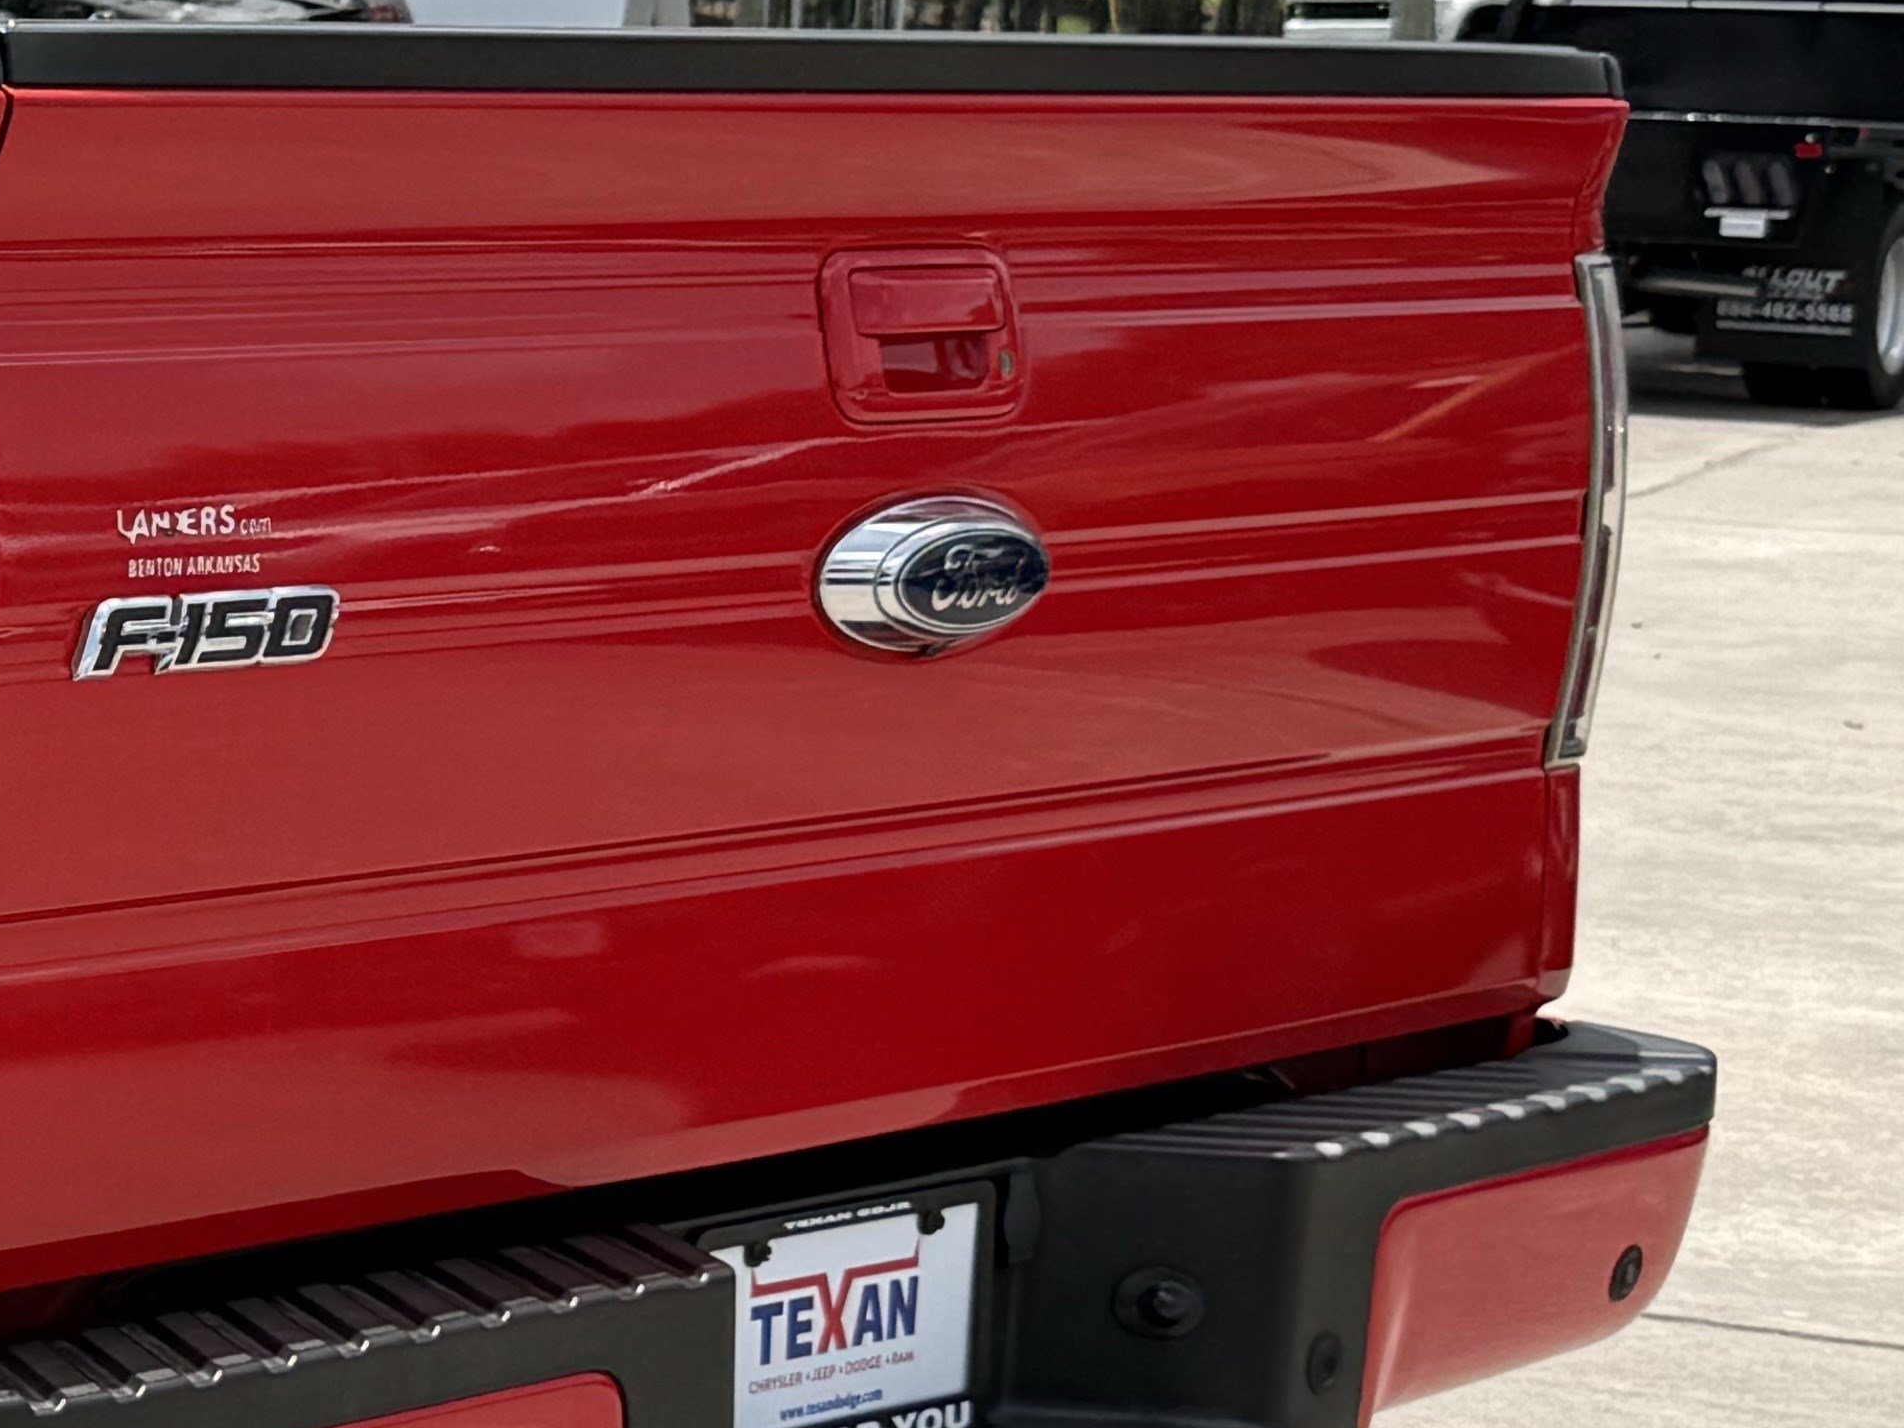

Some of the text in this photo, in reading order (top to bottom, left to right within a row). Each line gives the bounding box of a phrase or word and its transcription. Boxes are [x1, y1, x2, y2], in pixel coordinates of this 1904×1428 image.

[127, 552, 261, 578] BENTON ARKANSAS
[931, 542, 1026, 612] Ford
[72, 584, 341, 681] F-150
[782, 1210, 853, 1230] TEXAN
[749, 1270, 919, 1366] TEXAN
[748, 1350, 915, 1395] CHRYSLER JEEP DODGE RAM
